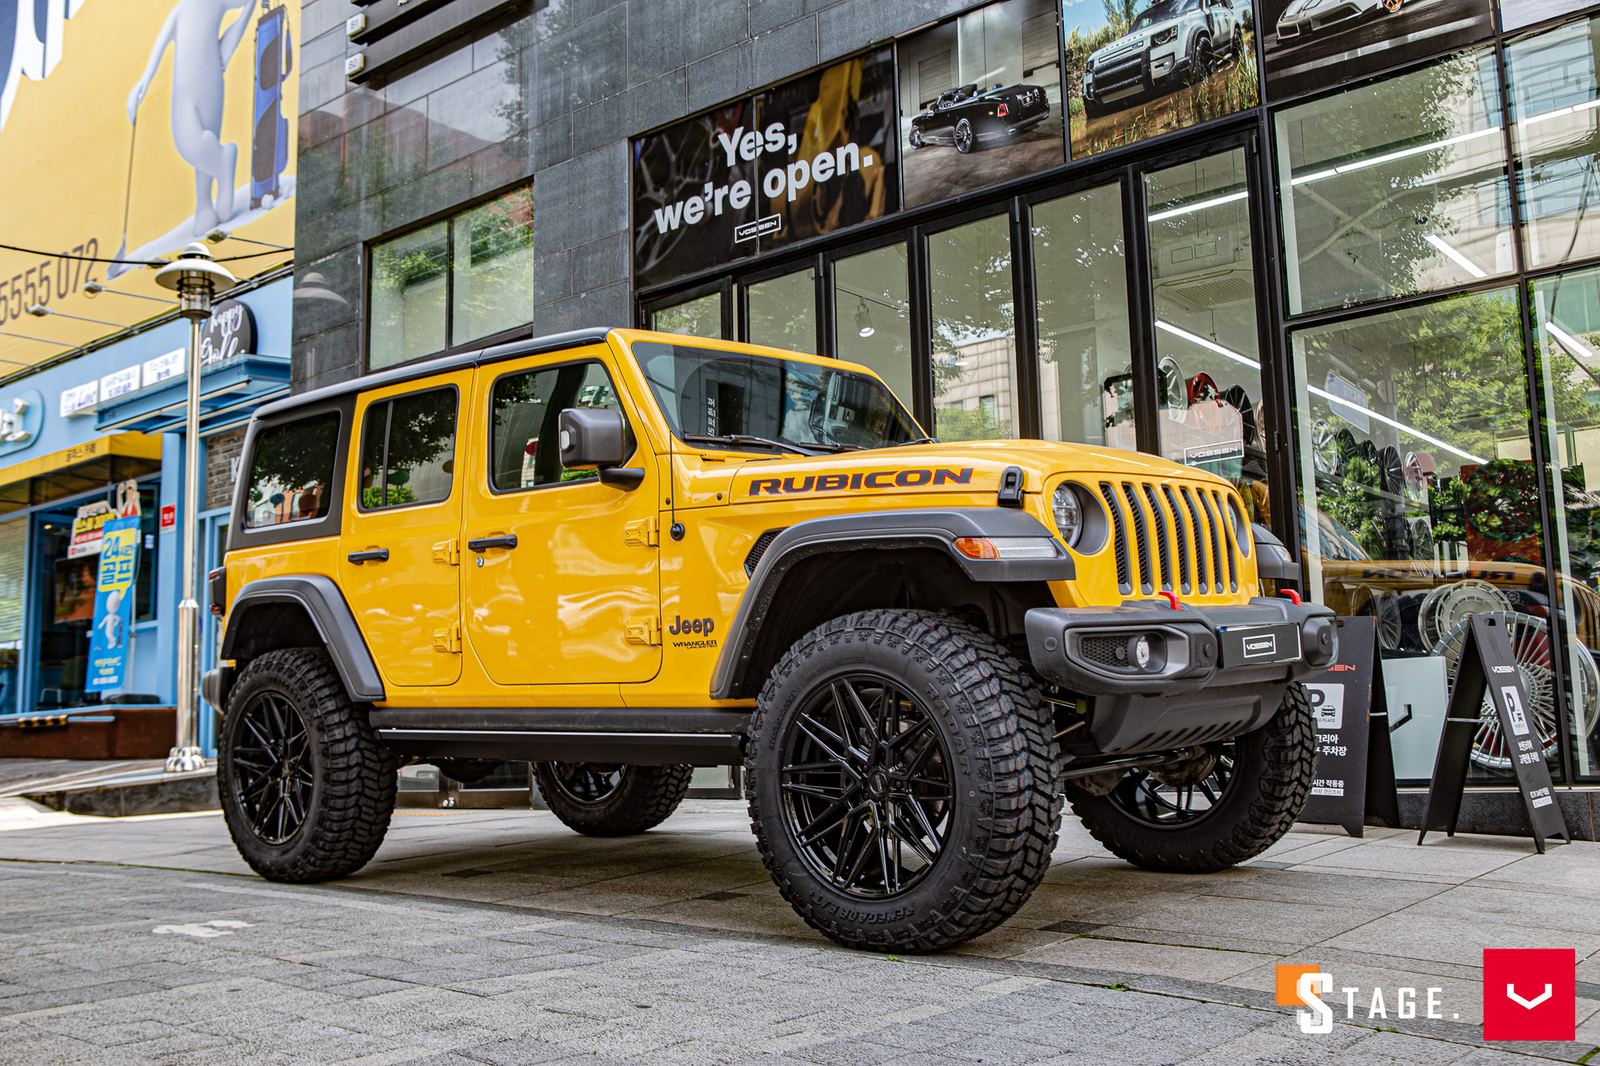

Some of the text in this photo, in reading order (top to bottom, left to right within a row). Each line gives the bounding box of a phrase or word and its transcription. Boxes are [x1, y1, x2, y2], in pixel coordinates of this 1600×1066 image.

[718, 122, 797, 167] Yes,
[654, 142, 873, 234] we're open.
[738, 220, 777, 236] VOSSEN
[1189, 446, 1239, 458] VOSSEN
[748, 467, 974, 497] RUBICON
[669, 615, 715, 637] Jeep
[672, 639, 718, 648] WRANGLER
[1322, 745, 1348, 757] 주차장
